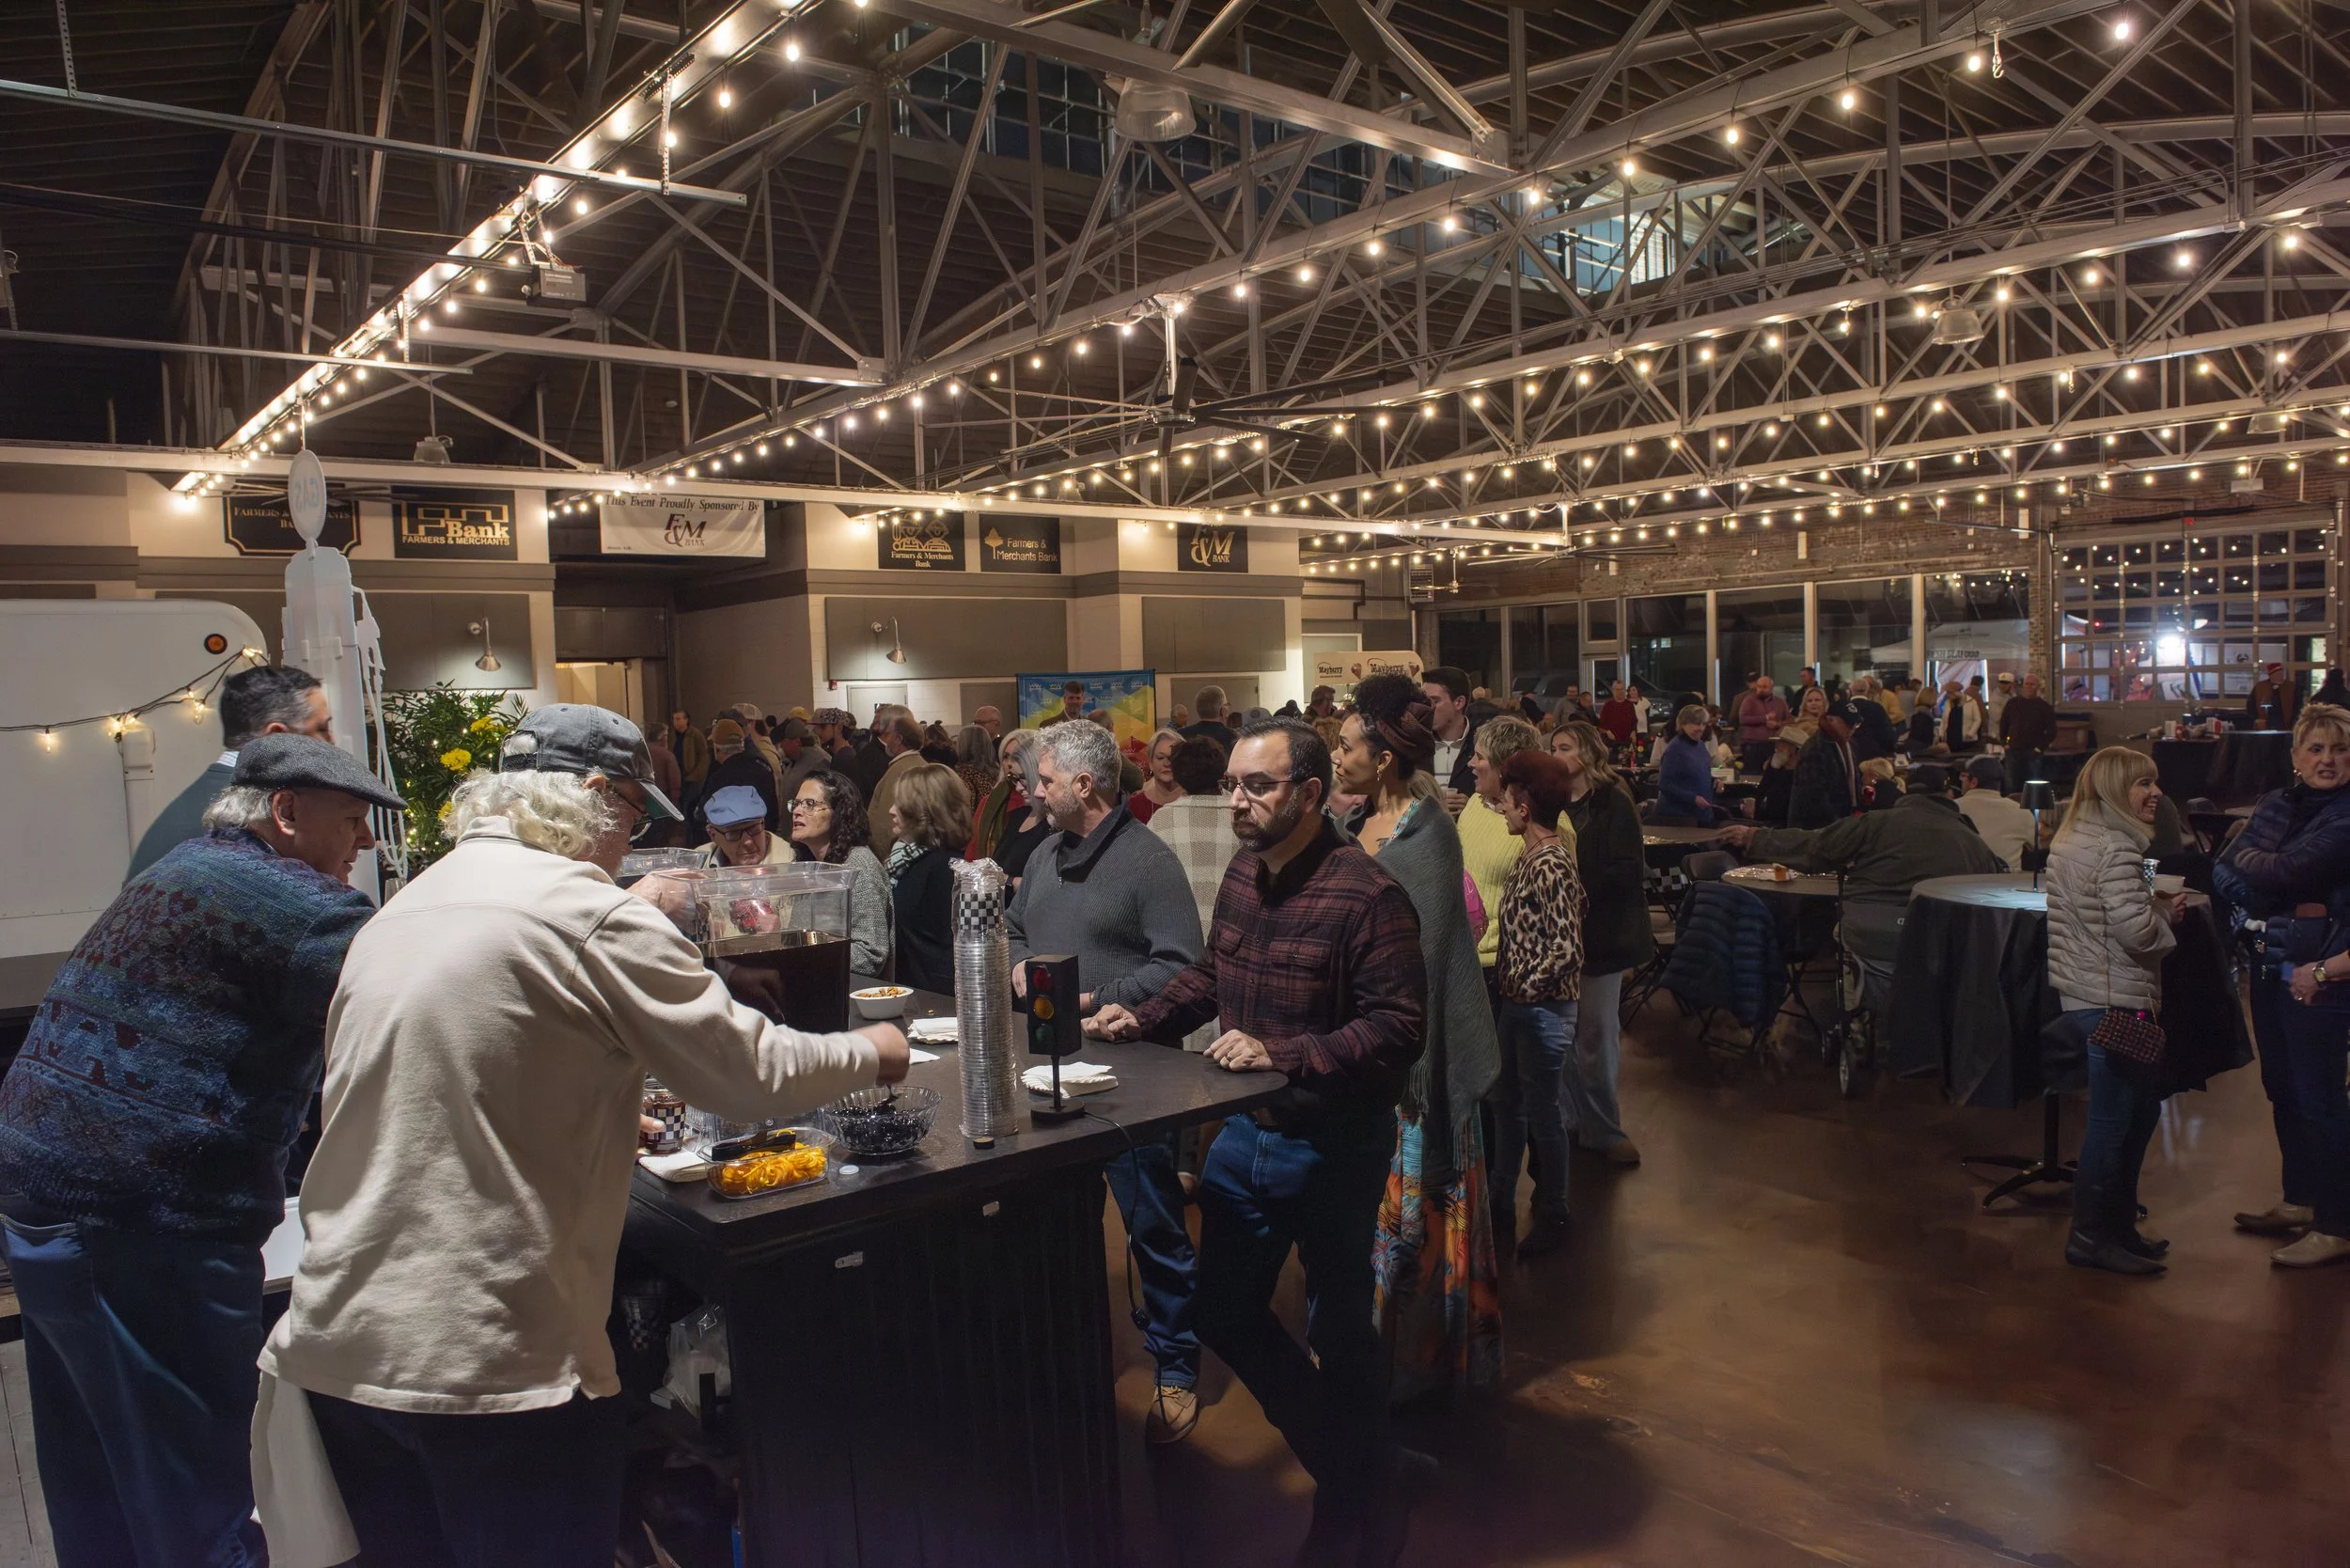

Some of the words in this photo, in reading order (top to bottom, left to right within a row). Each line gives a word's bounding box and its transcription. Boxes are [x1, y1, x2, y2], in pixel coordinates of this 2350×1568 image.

[605, 494, 626, 506] This
[631, 496, 655, 508] Event
[660, 499, 695, 511] Proudly
[699, 500, 744, 511] Sponsored
[748, 501, 760, 514] By
[234, 507, 279, 517] FARMERS
[446, 521, 509, 539] Bank
[402, 535, 446, 544] FARMERS
[447, 536, 454, 544] &
[456, 537, 510, 546] MERCHANTS
[1007, 538, 1038, 548] Farmers
[1041, 540, 1046, 548] &
[891, 551, 916, 559] Farmers
[924, 552, 954, 560] Merchants
[996, 550, 1036, 561] Merchants
[1038, 551, 1058, 562] Bank
[1213, 555, 1230, 563] BANK
[916, 559, 931, 568] Bank
[1319, 666, 1342, 675] Mayberry
